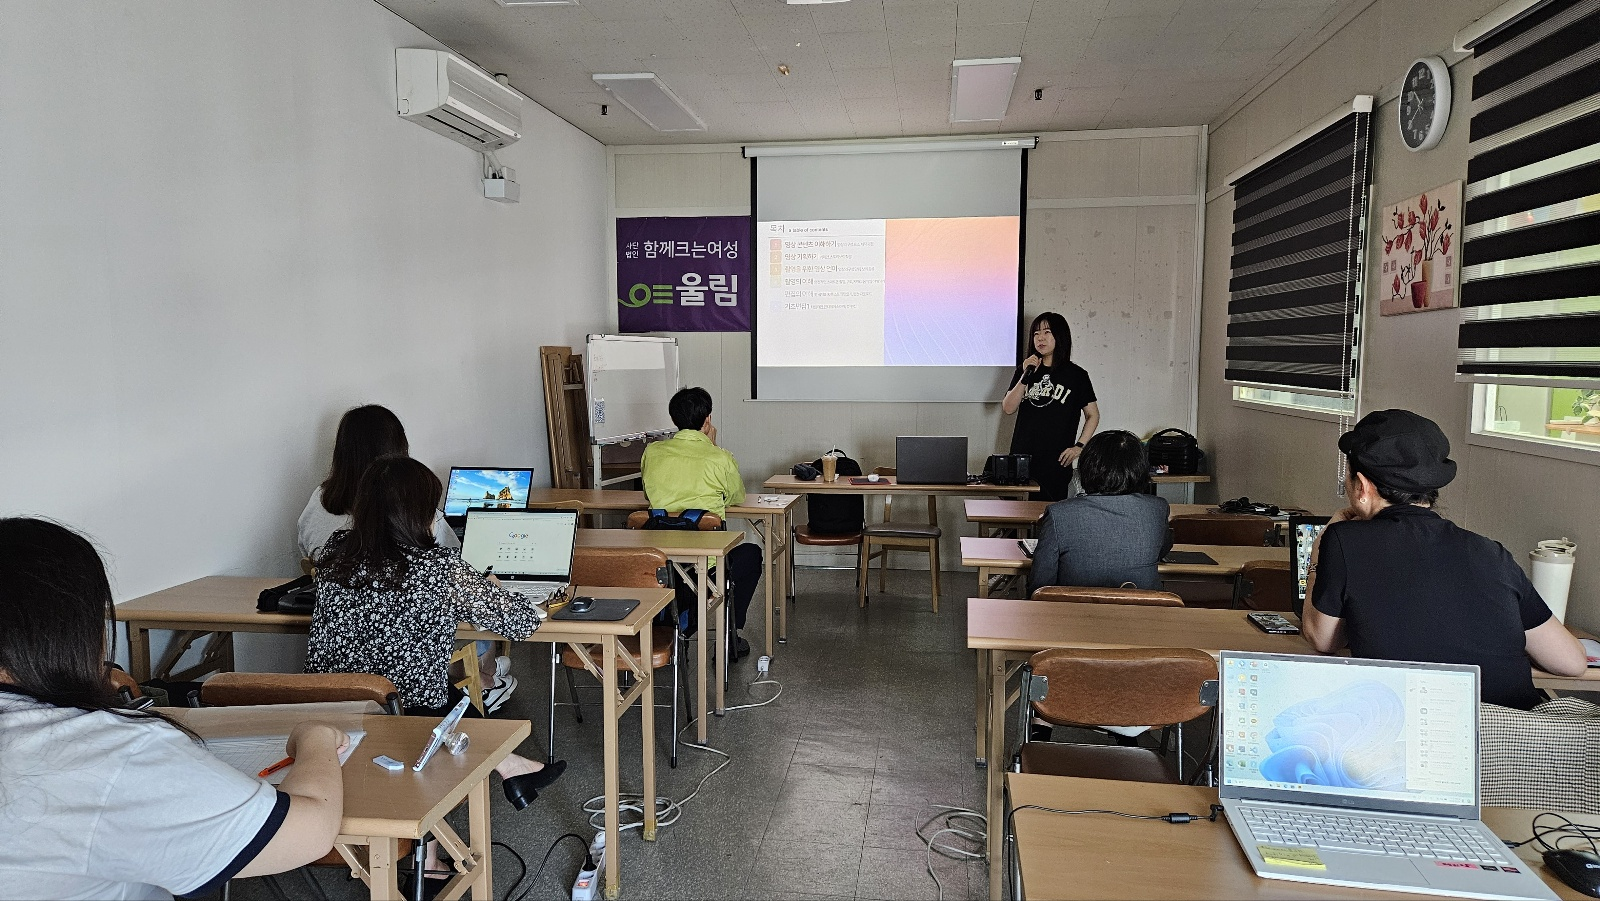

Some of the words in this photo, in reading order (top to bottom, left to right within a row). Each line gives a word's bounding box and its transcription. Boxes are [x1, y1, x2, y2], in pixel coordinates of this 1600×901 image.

[1418, 67, 1425, 80] 12
[1412, 76, 1418, 87] 11
[1406, 105, 1411, 116] 9
[1407, 119, 1413, 130] 8
[1412, 128, 1417, 140] 7
[625, 241, 639, 250] 사단
[643, 240, 738, 259] 함께크는여성
[785, 241, 796, 249] 영상
[625, 250, 639, 259] 법인
[508, 531, 529, 539] Google
